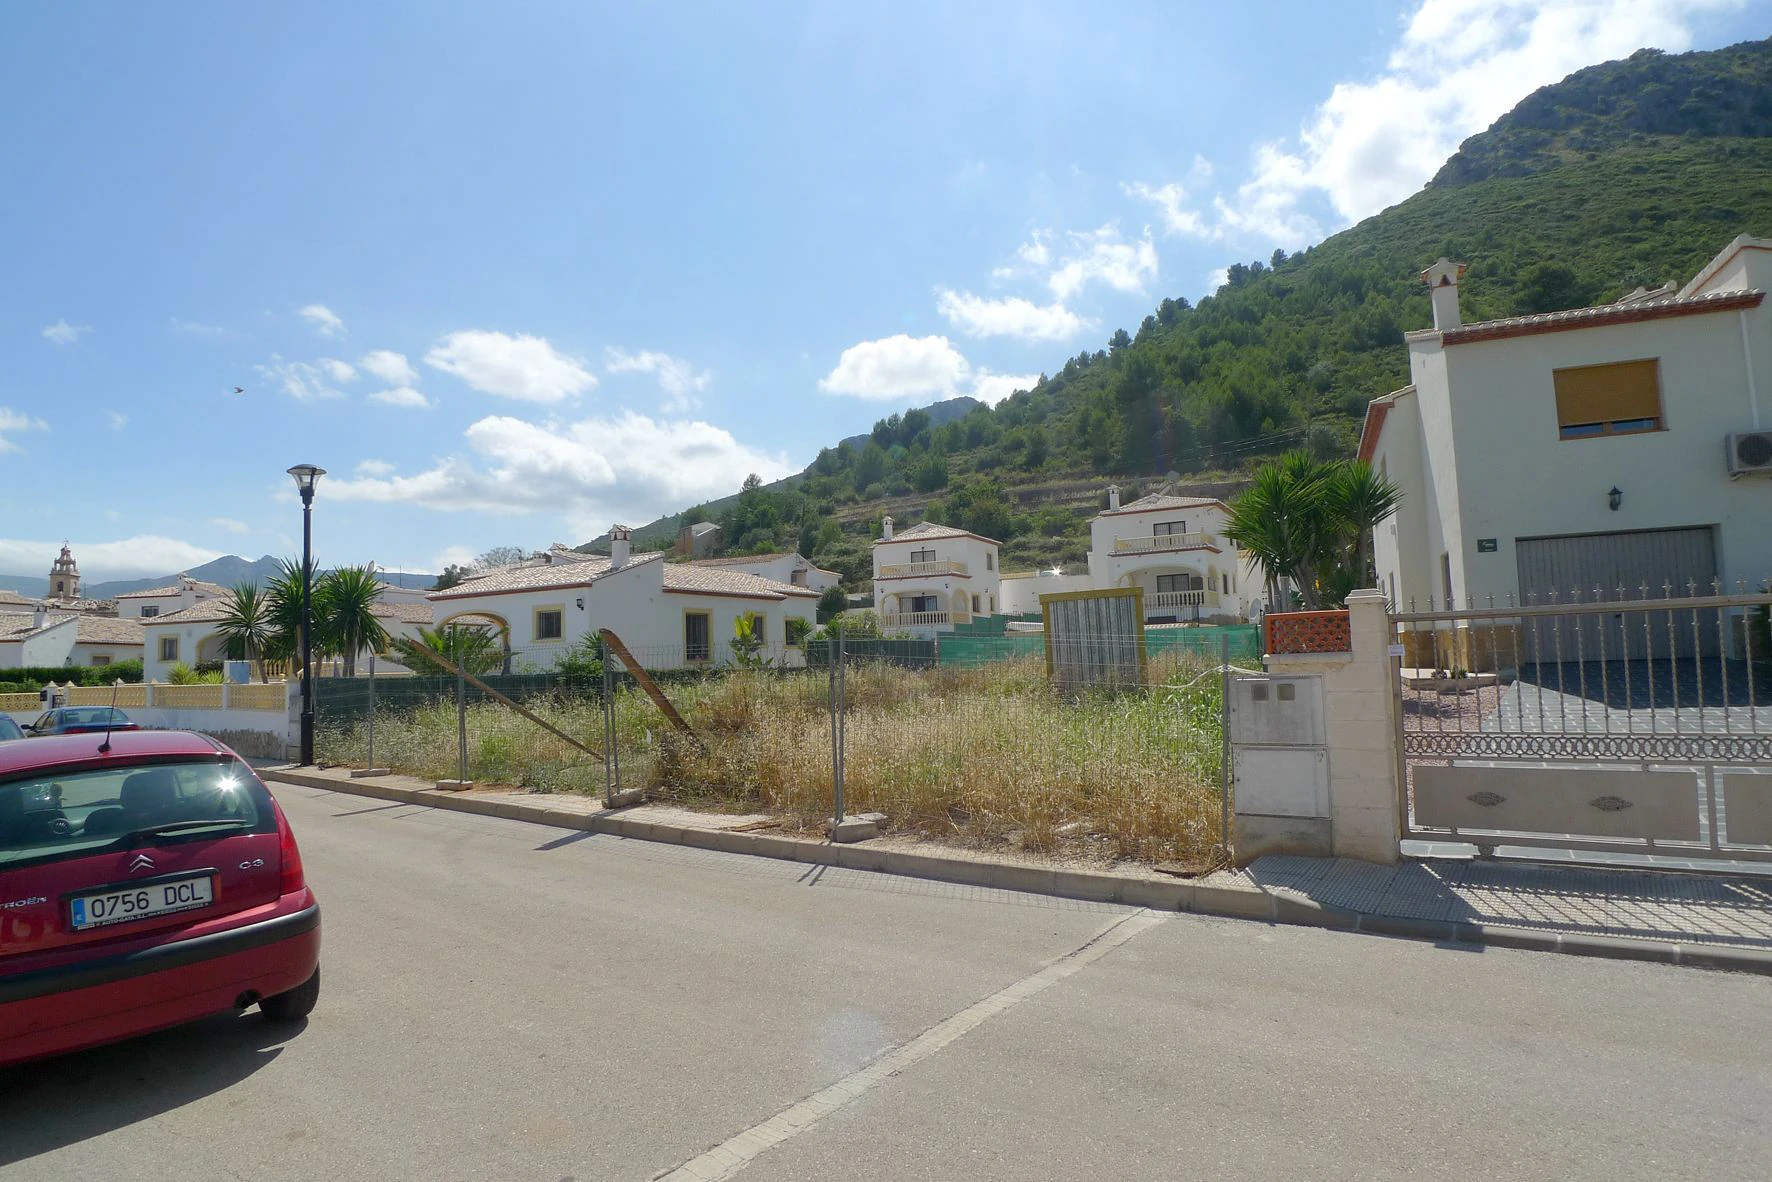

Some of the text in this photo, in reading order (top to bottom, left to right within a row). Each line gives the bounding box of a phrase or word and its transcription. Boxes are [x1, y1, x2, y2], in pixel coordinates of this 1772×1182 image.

[239, 858, 264, 870] C3
[91, 891, 150, 918] 0756
[163, 882, 204, 906] DCL
